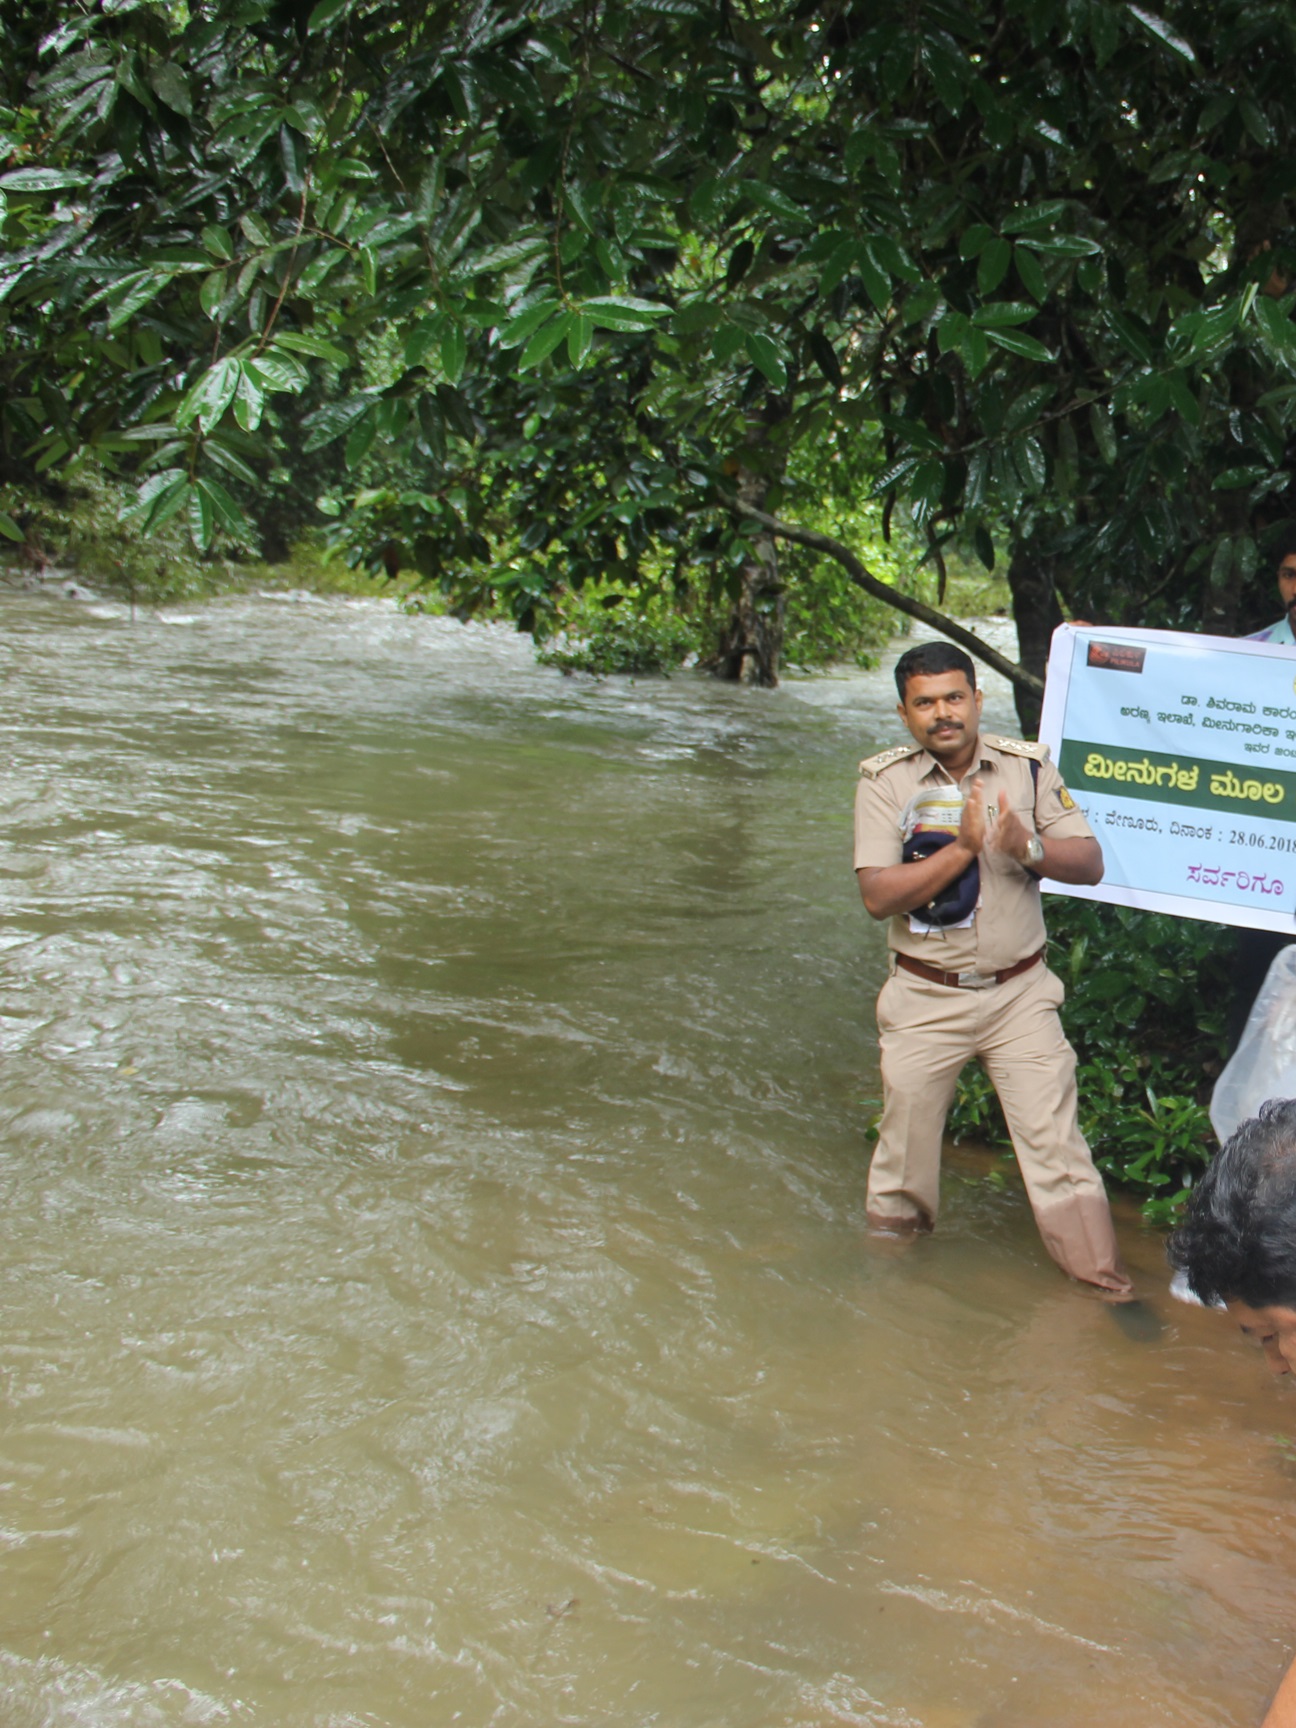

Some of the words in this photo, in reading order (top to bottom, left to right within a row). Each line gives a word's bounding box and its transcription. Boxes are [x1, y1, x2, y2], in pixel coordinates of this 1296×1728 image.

[1206, 697, 1257, 714] ಶಿವರಾಮ
[1120, 706, 1151, 724] ಅರಣ್ಯ
[1202, 716, 1279, 737] ಮೀನುಗಾರಿಕಾ
[1244, 742, 1270, 754] ಇವರ
[1084, 752, 1199, 791] ಮೀನುಗಳ
[1209, 770, 1285, 803] ಮೂಲ
[1169, 821, 1213, 840] ದಿನಾಂಕ
[1186, 863, 1284, 896] ಸರ್ವರಿಗೂ
